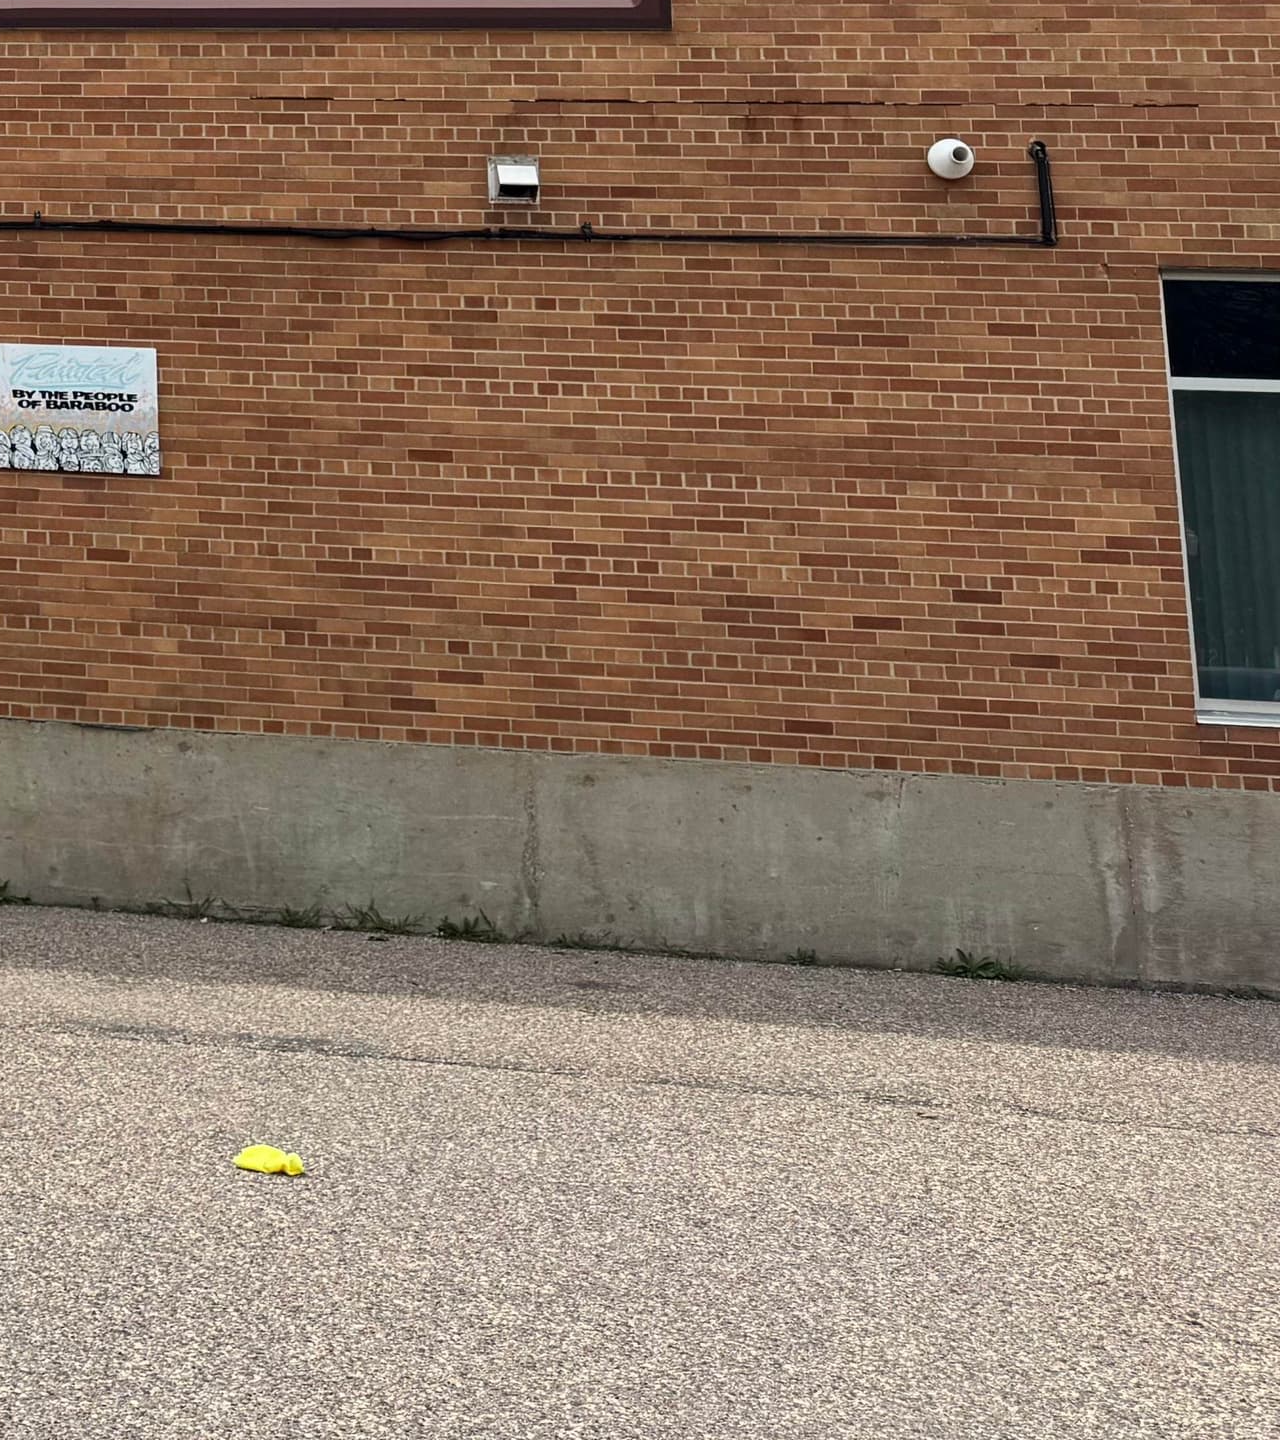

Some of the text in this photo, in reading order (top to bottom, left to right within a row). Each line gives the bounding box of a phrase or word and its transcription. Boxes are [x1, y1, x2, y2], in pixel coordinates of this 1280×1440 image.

[12, 389, 138, 403] BY THE PEOPLE
[18, 399, 134, 412] OF BARABOO
